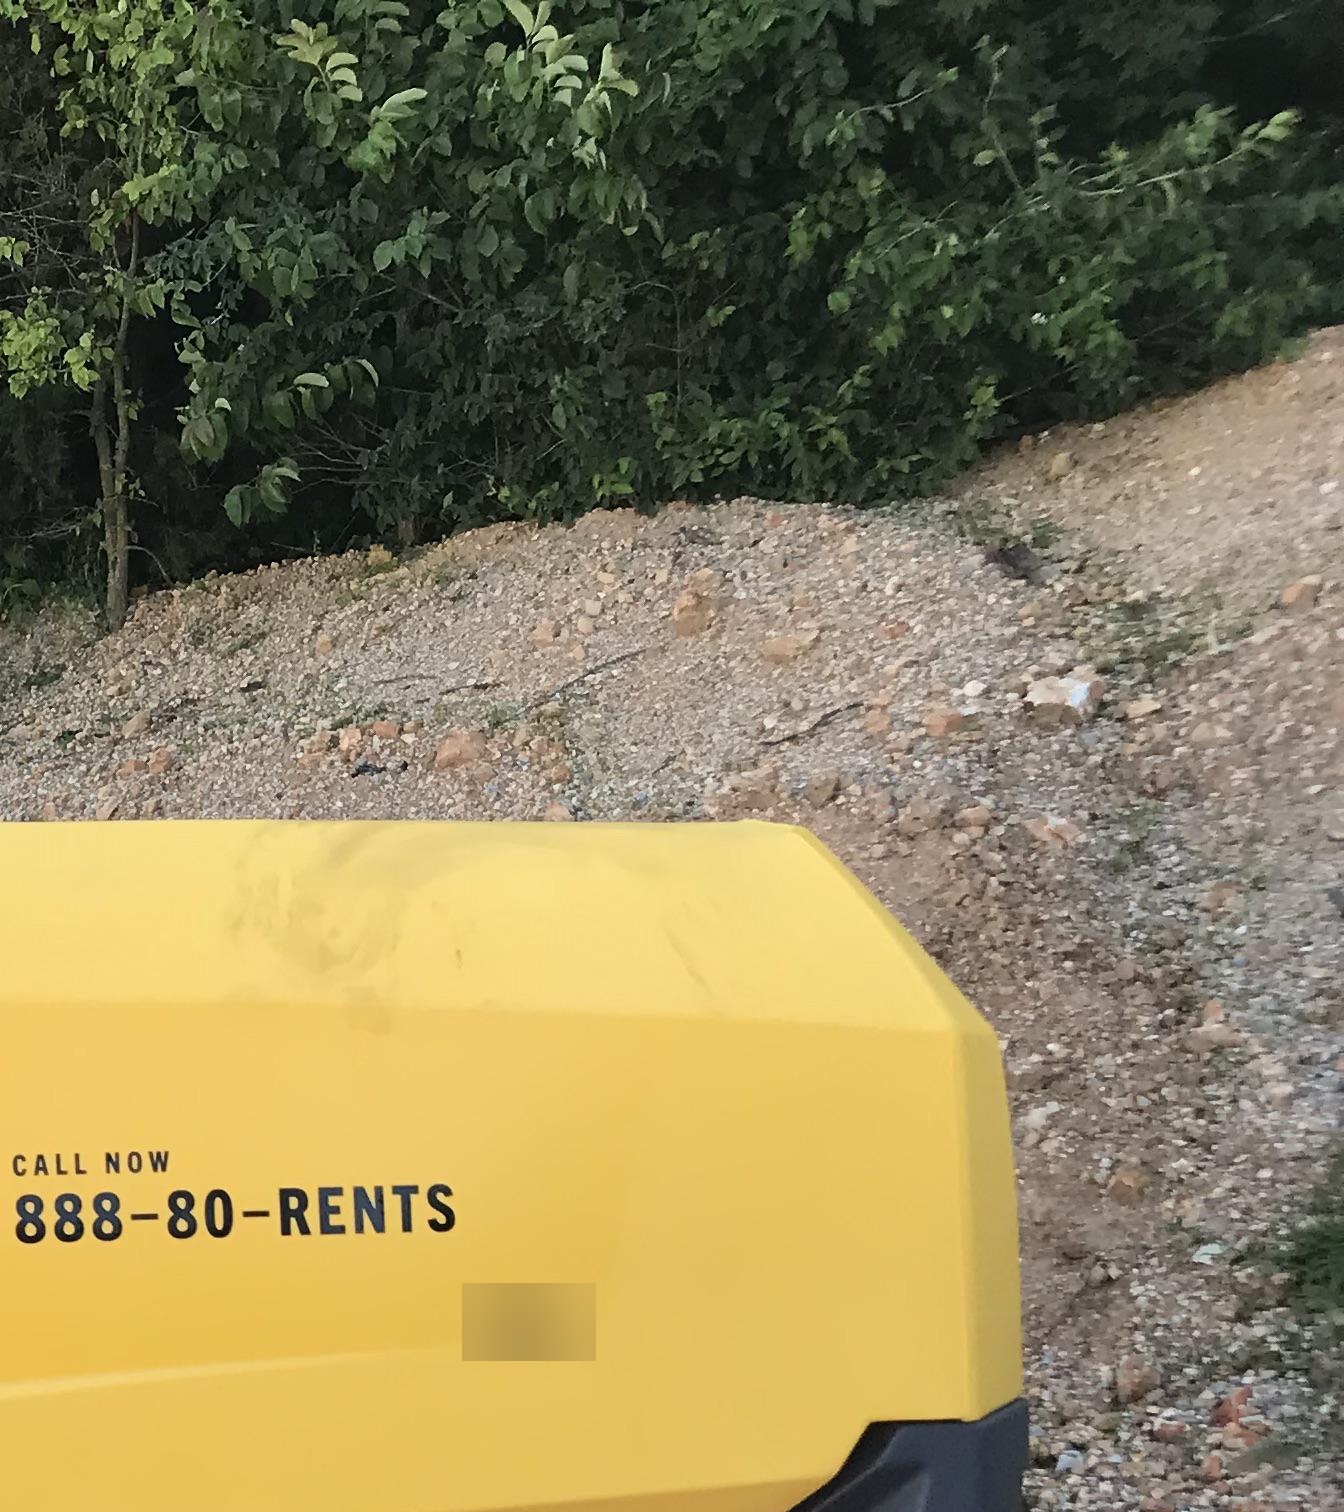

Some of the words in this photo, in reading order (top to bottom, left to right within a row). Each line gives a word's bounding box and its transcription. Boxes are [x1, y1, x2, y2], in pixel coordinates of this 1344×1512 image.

[11, 1152, 88, 1178] CALL
[104, 1149, 171, 1175] NOW
[14, 1182, 458, 1245] 888-80-RENTS
